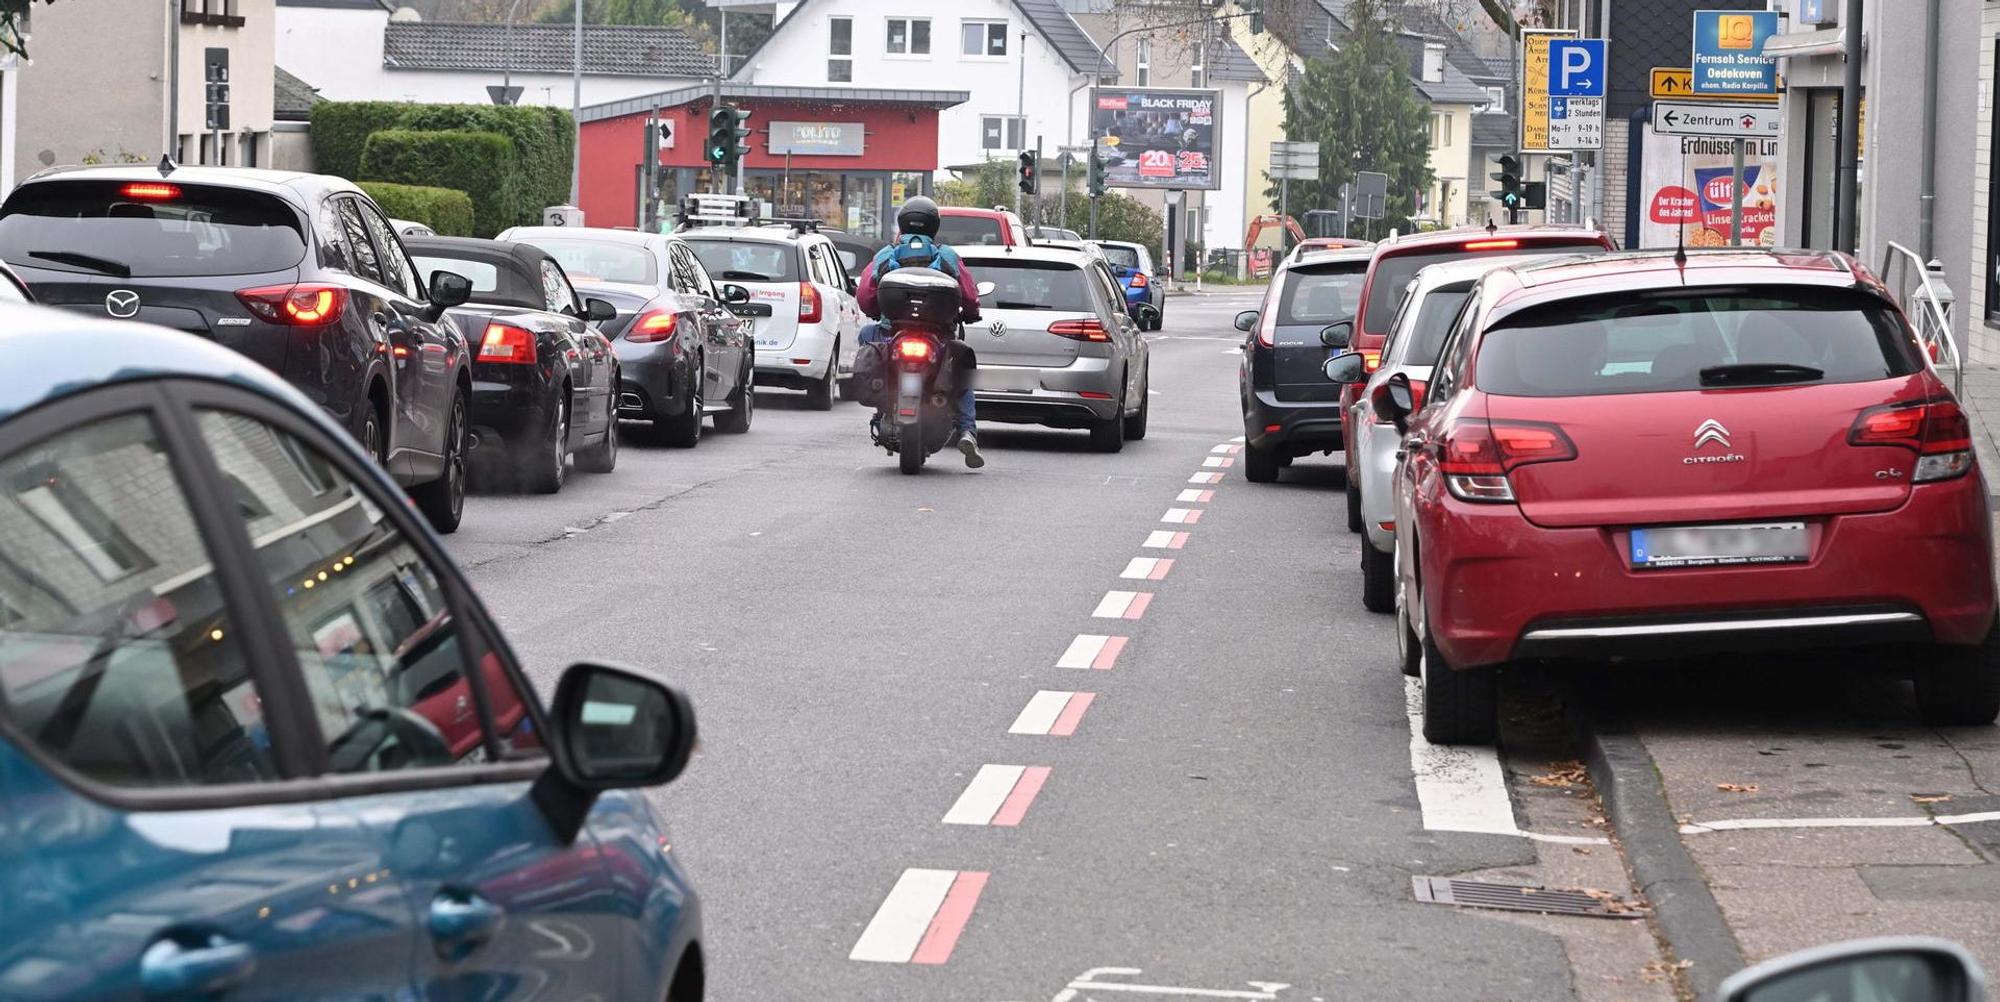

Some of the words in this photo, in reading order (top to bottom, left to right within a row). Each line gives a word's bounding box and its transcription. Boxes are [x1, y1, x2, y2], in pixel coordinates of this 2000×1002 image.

[1696, 53, 1735, 64] Fernseh
[1737, 53, 1775, 65] Service
[1562, 47, 1591, 89] P
[1707, 68, 1763, 79] Oedekoven
[1683, 78, 1692, 90] K
[1722, 81, 1741, 89] Radio
[1141, 98, 1174, 108] BLACK
[1177, 99, 1213, 109] FRIDAY
[1570, 97, 1600, 107] werktags
[1567, 109, 1572, 117] 2
[1575, 109, 1601, 117] Stunden
[1683, 114, 1734, 126] Zentrum
[1578, 124, 1592, 132] 9-19
[1551, 136, 1560, 144] Sa
[1577, 136, 1592, 144] 9-14
[1681, 136, 1735, 155] Erdnüsse
[1760, 139, 1778, 156] Lin
[1659, 197, 1669, 206] Der
[1659, 208, 1669, 217] des
[1707, 214, 1732, 225] Linse
[755, 338, 778, 347] nik.de
[1875, 468, 1903, 480] C4
